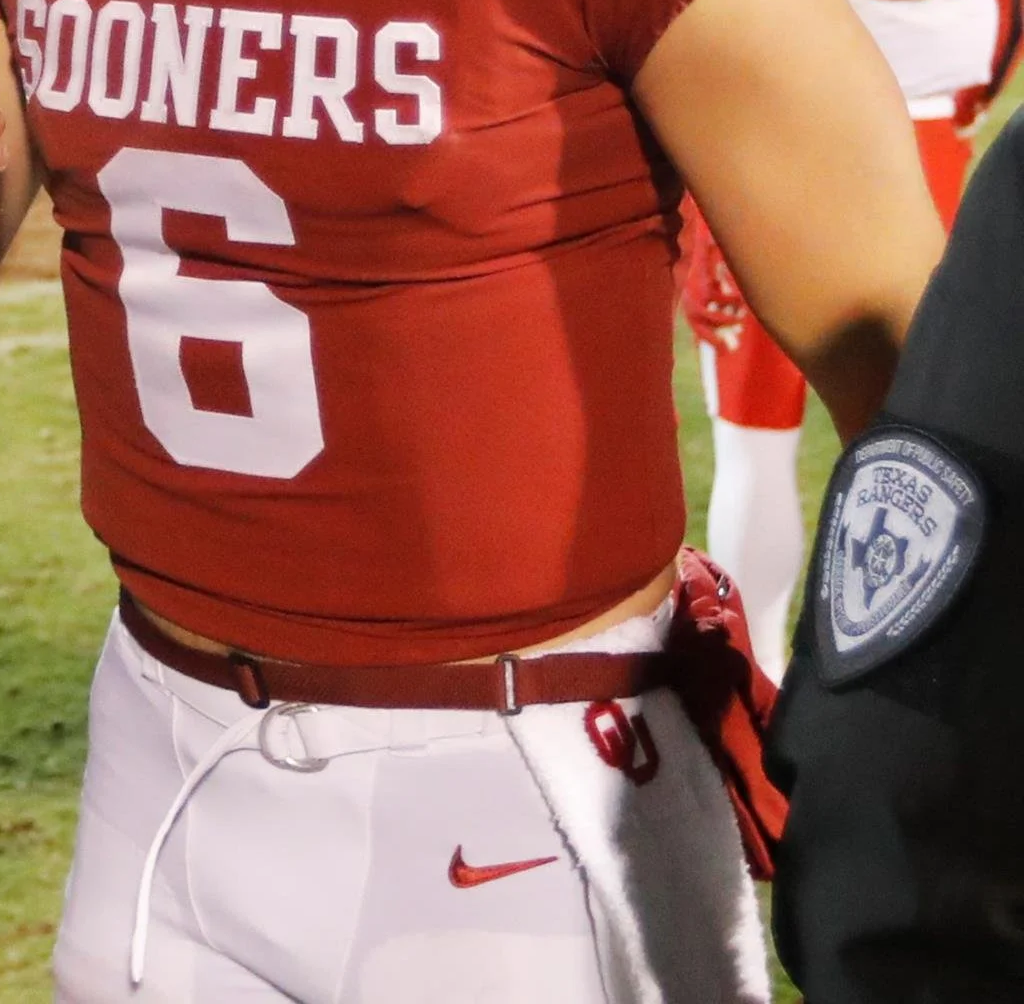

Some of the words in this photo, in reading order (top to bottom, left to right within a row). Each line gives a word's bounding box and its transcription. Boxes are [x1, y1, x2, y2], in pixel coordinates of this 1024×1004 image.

[96, 146, 326, 481] 6
[873, 465, 934, 504] TEXAS
[856, 485, 939, 538] RANGERS
